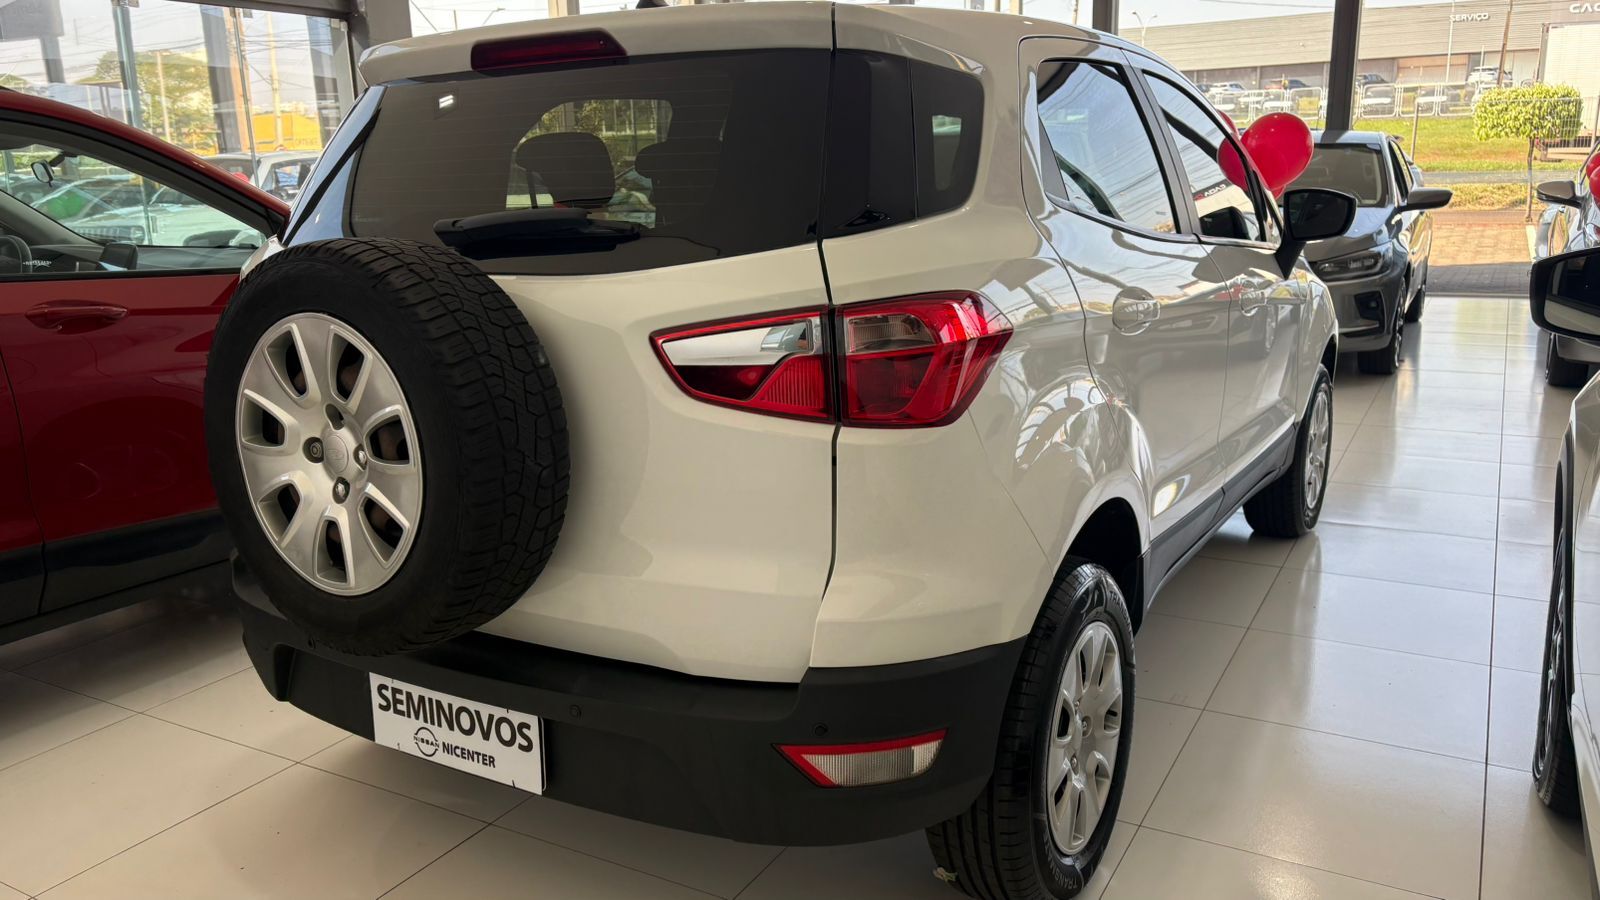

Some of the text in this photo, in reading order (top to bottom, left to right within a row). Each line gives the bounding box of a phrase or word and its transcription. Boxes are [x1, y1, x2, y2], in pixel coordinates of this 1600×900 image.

[1449, 12, 1489, 22] SERVIÇO
[377, 683, 533, 753] SEMINOVOS
[413, 735, 440, 749] NISSAN
[442, 741, 496, 768] NICENTER
